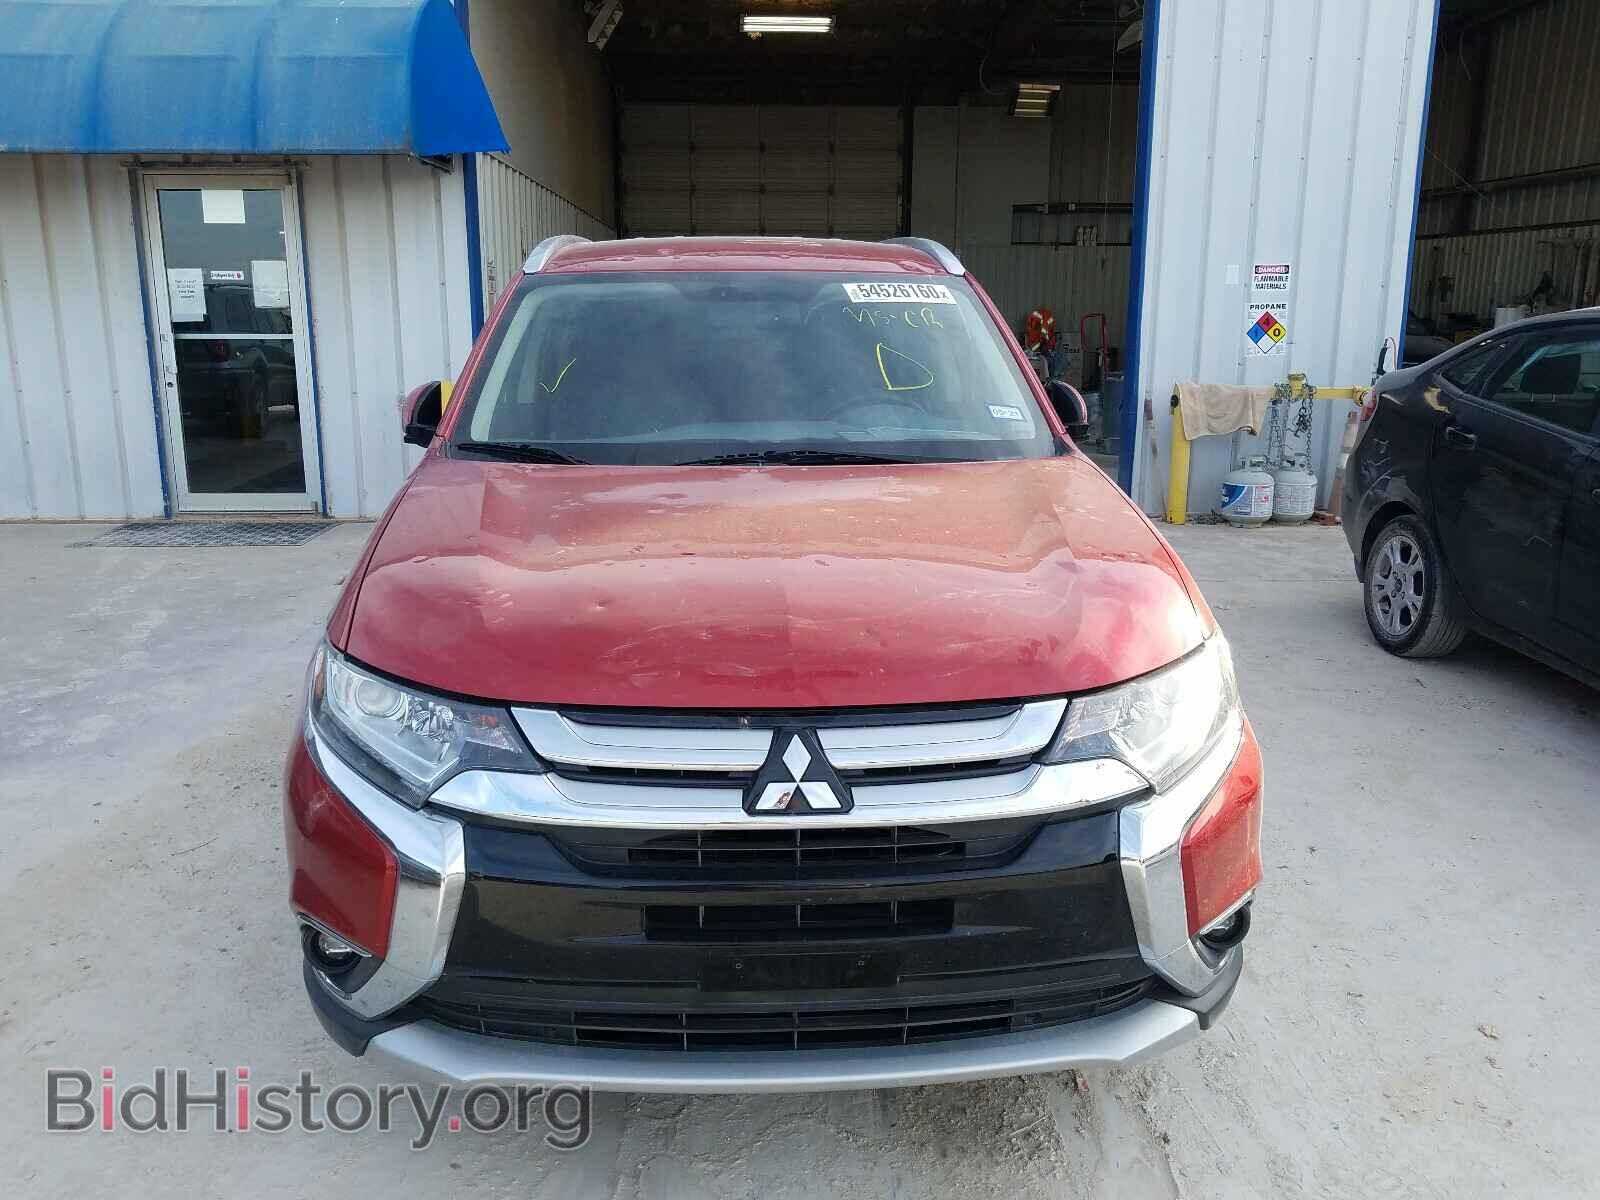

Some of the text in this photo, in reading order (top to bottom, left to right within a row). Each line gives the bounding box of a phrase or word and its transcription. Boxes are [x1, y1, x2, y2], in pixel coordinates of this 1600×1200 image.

[1257, 265, 1287, 273] DANGER
[858, 284, 940, 299] 54526160
[1273, 328, 1281, 337] 0
